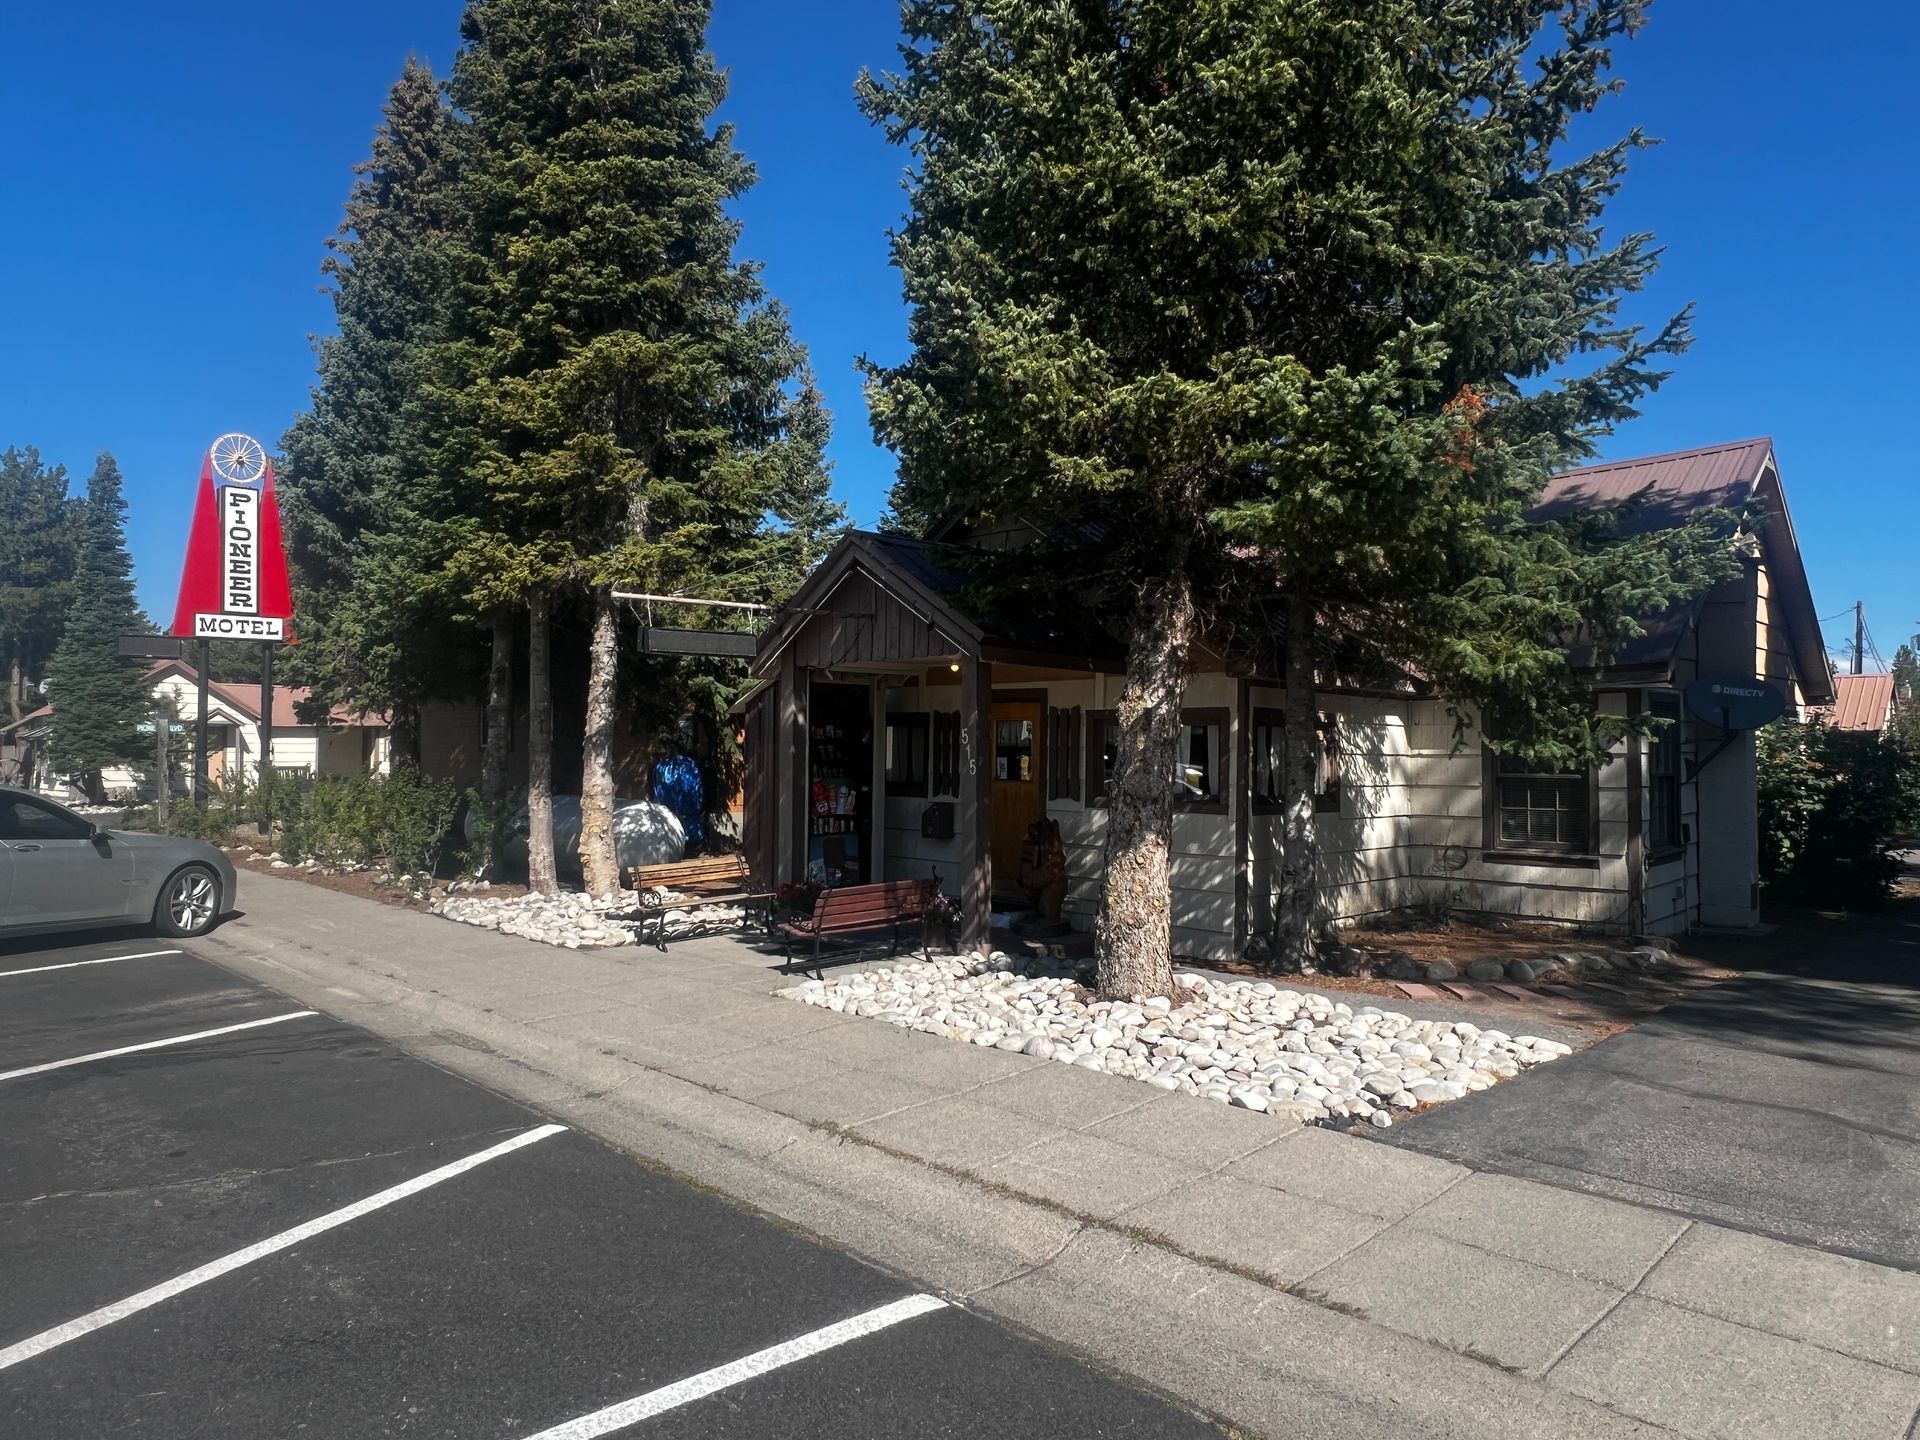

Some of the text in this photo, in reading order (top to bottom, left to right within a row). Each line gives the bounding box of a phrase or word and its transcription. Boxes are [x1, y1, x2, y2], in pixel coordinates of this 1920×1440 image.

[229, 492, 252, 607] PIONEER
[199, 617, 279, 636] MOTEL
[1723, 686, 1765, 697] DIRECTV
[961, 728, 977, 775] 515
